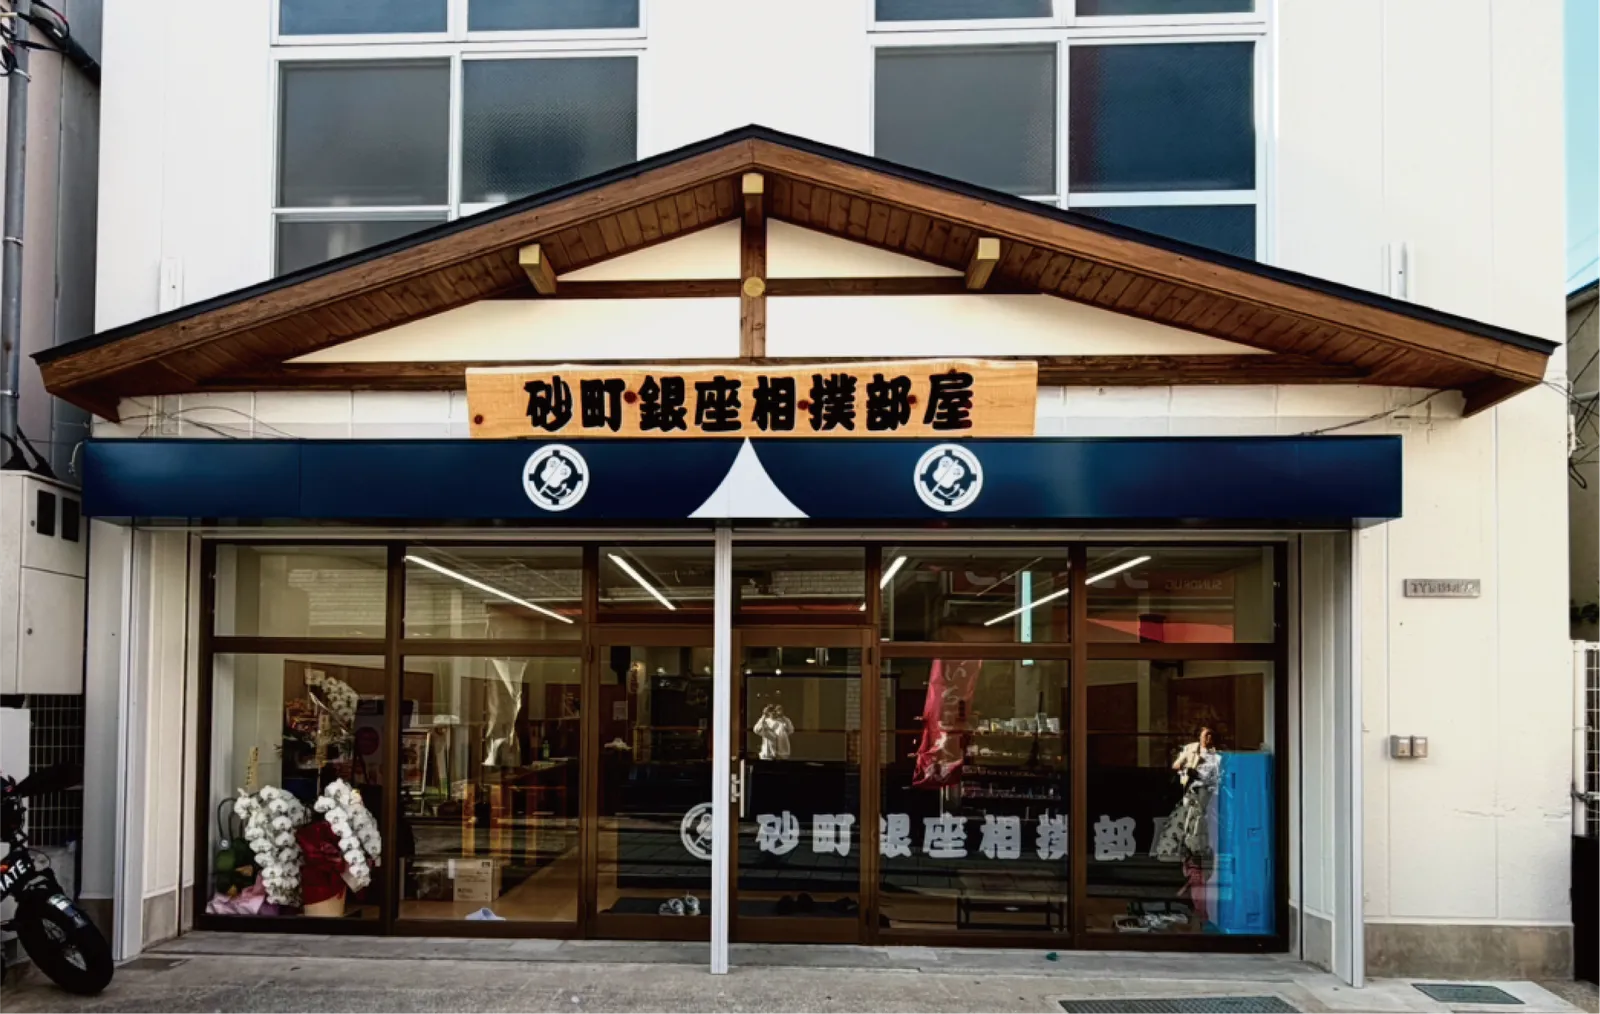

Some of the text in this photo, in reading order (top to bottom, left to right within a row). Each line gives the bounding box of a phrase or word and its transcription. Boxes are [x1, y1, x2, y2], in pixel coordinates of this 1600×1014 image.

[523, 371, 974, 432] 砂町銀座相撲部屋
